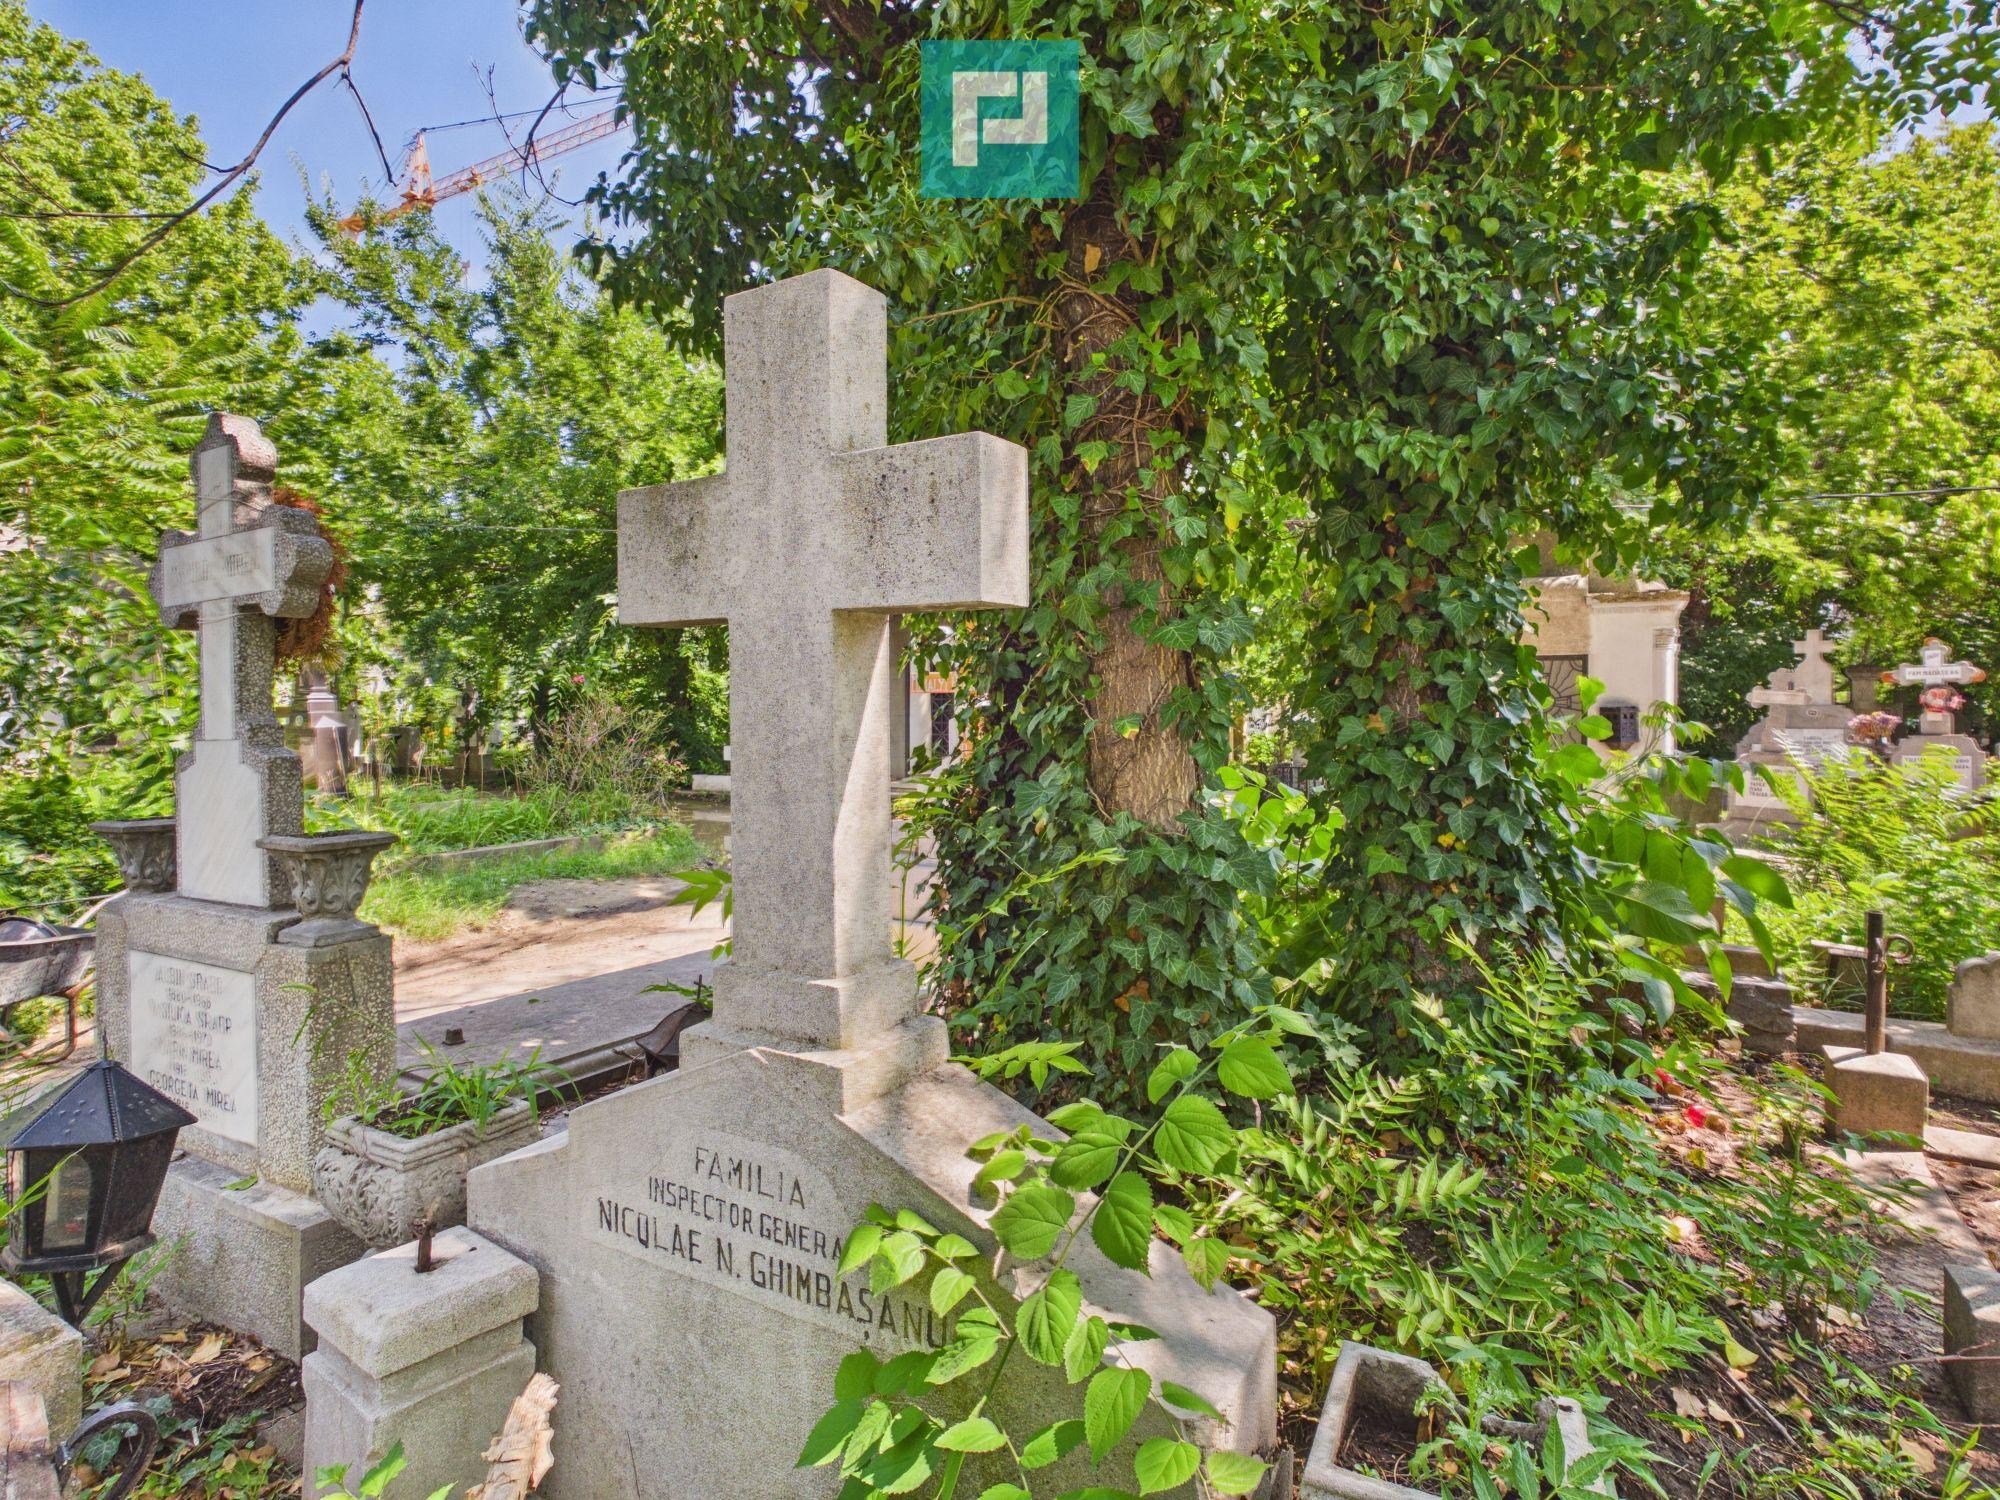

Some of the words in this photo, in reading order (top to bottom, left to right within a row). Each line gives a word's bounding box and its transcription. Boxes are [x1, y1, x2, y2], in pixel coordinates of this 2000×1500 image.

[191, 1047, 222, 1071] MIREA
[149, 1069, 199, 1100] GEORGETA
[206, 1087, 238, 1114] MIREA
[695, 1146, 806, 1210] FAMILIA
[597, 1196, 703, 1265] NICOLAE
[716, 1237, 742, 1280] N.
[648, 1175, 754, 1235] INSPECTOR
[759, 1212, 843, 1262] GENERA
